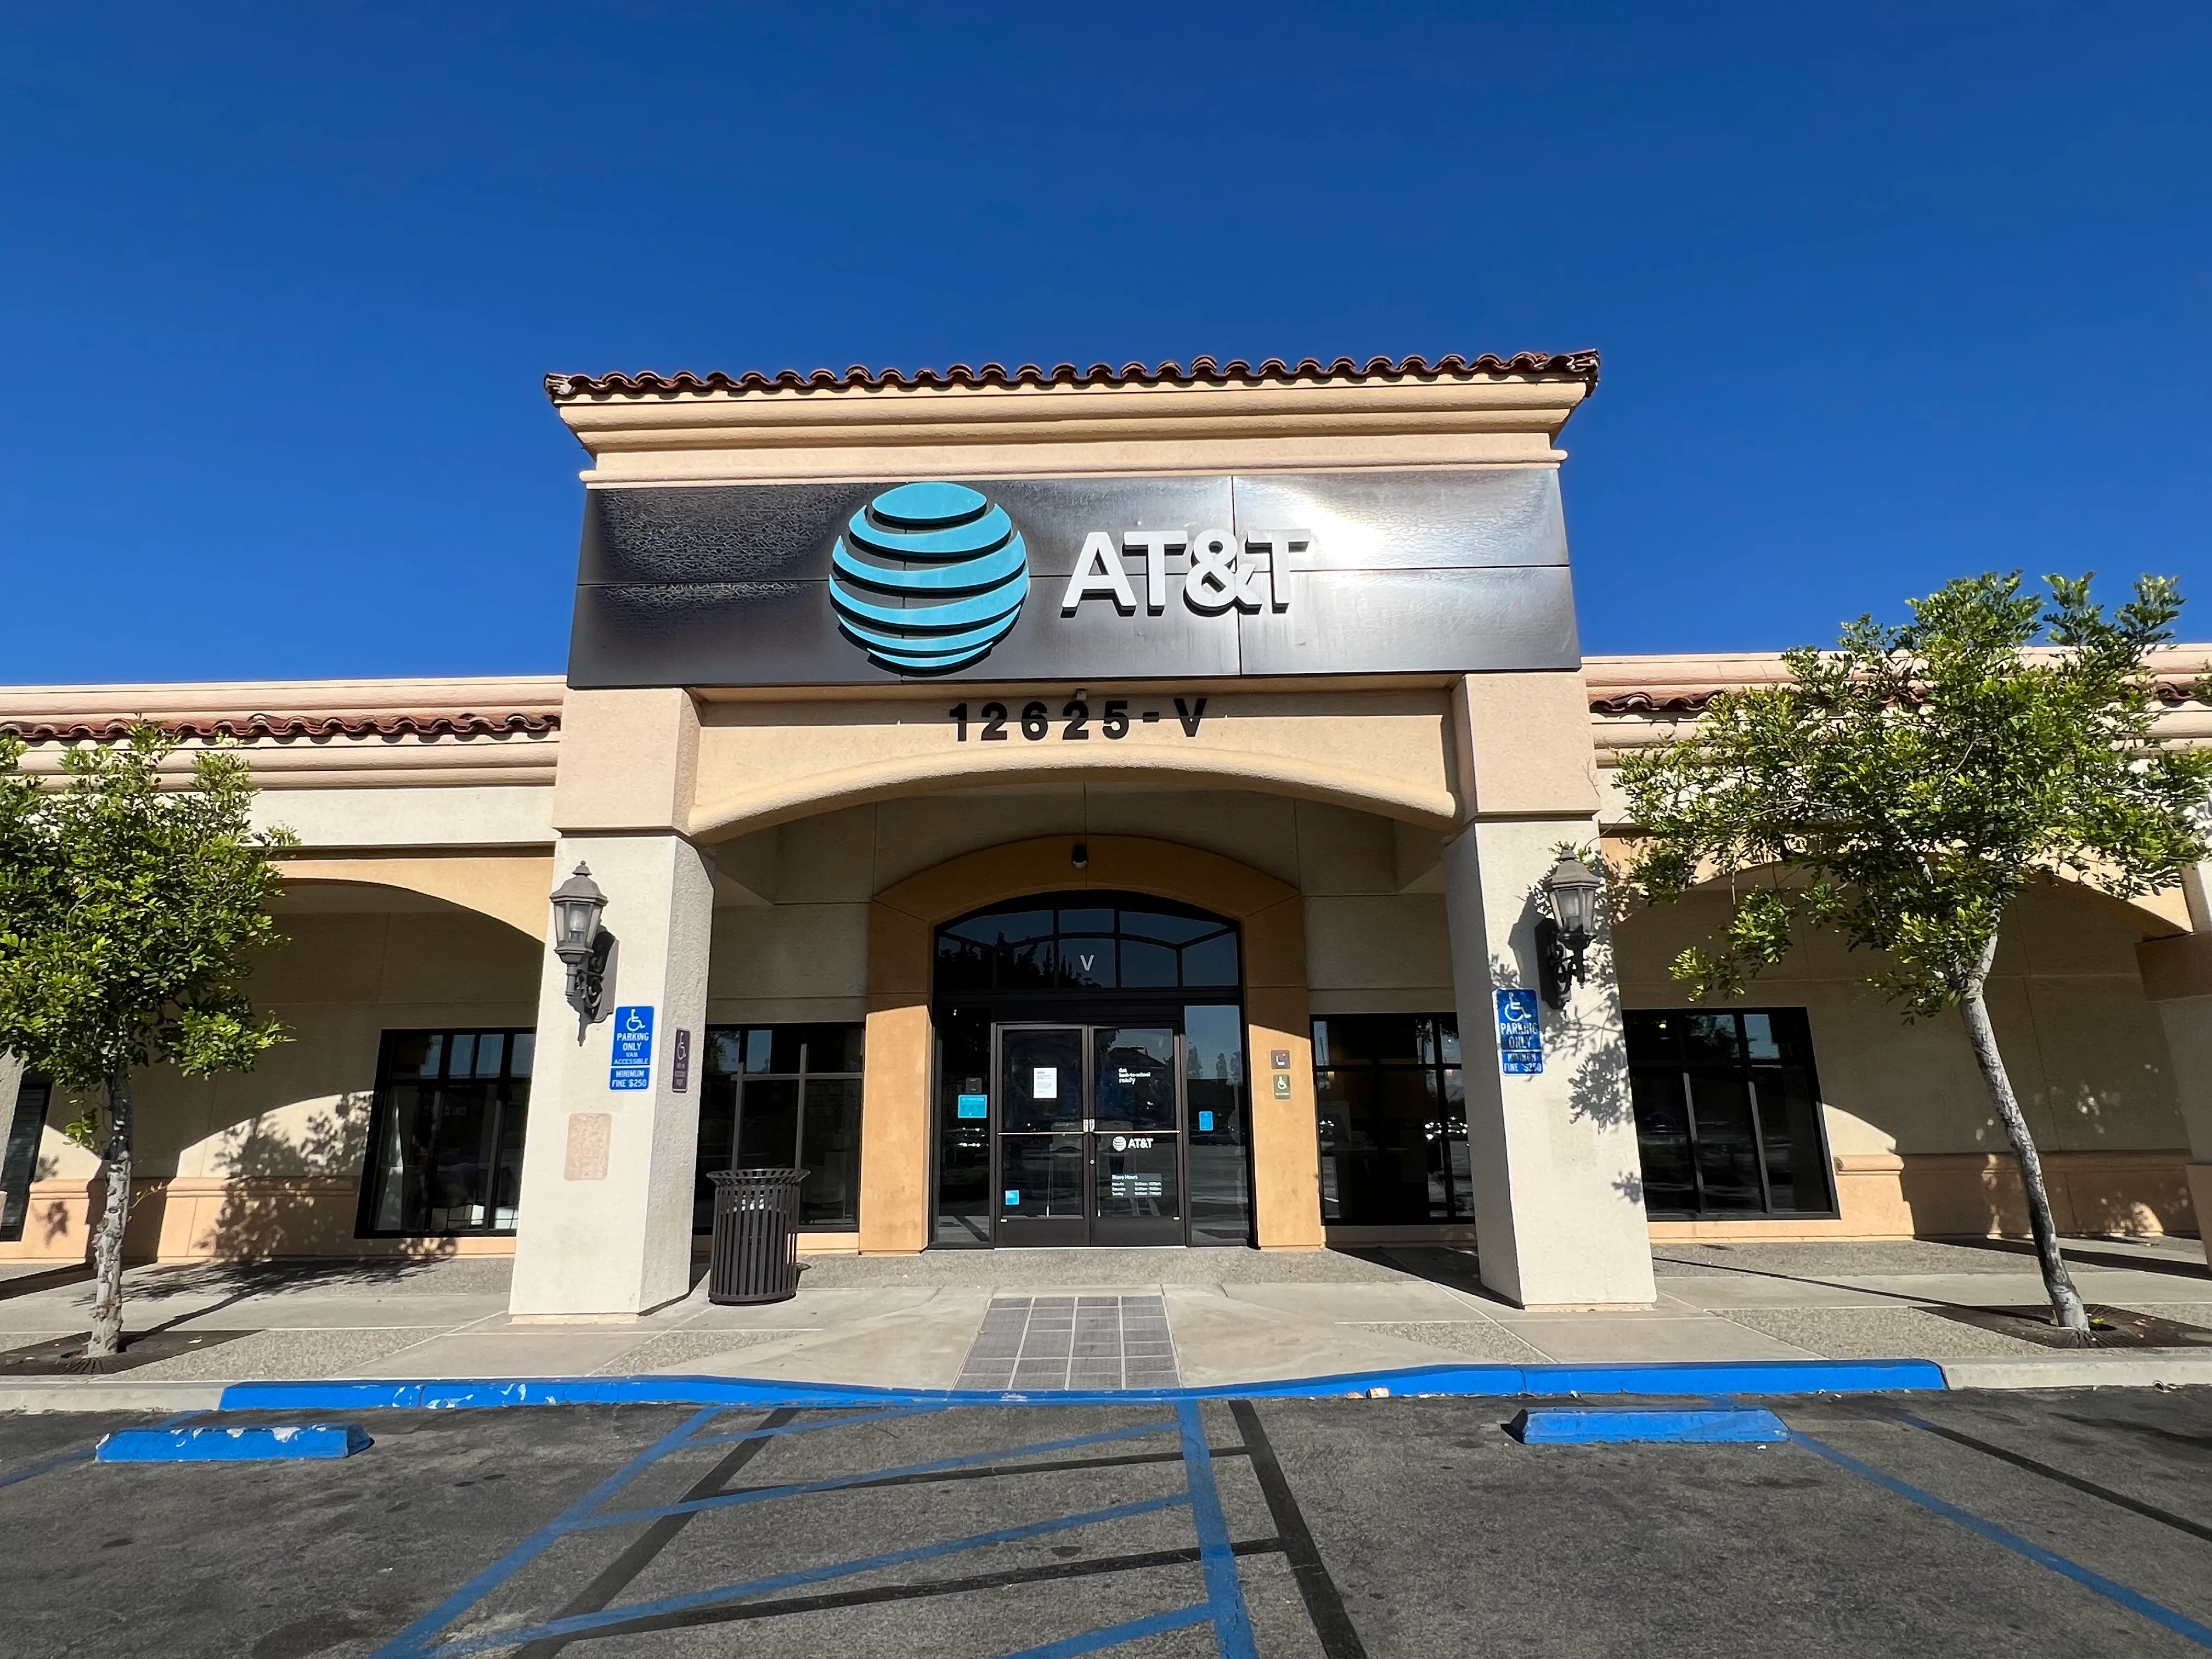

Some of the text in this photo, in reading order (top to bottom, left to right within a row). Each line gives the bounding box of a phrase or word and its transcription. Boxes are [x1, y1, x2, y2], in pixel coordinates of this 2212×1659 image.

[1060, 528, 1311, 618] AT&T
[949, 698, 1207, 742] 12625-V
[1080, 955, 1094, 970] V
[1500, 1023, 1538, 1035] PARKING
[617, 1032, 650, 1041] PARKING
[1509, 1036, 1532, 1048] ONLY
[622, 1042, 642, 1051] ONLY
[1504, 1063, 1519, 1072] FINE
[611, 1079, 647, 1087] FINE $250
[1128, 1138, 1154, 1149] AT&T
